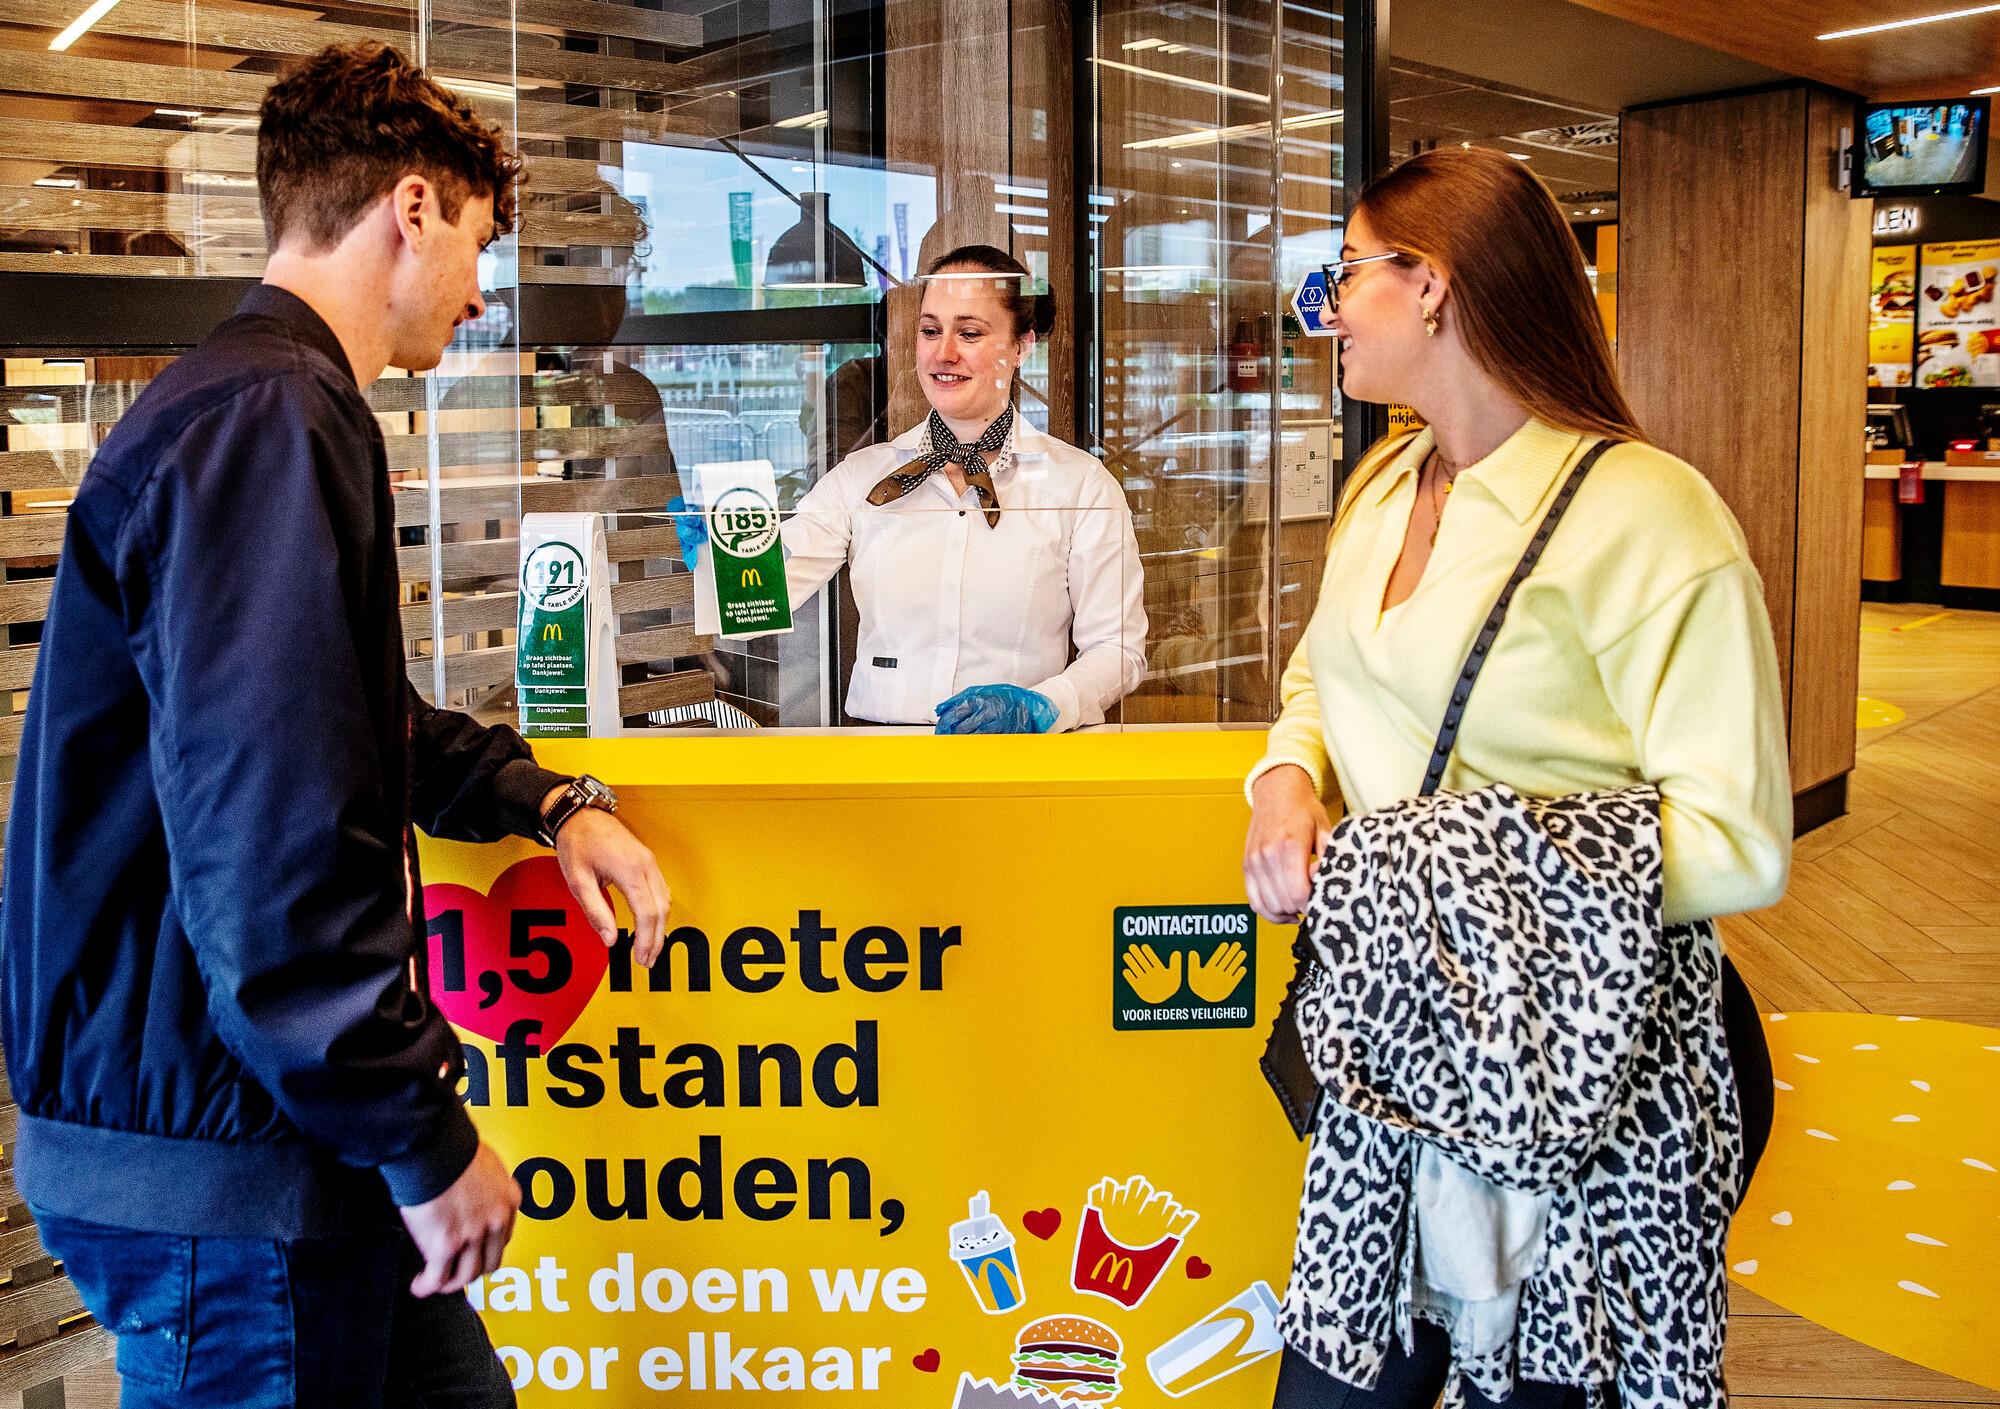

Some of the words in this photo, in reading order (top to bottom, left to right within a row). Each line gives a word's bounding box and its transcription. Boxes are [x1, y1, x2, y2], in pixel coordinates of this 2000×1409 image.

[1872, 208, 1919, 235] LEN
[1301, 303, 1324, 313] record
[1390, 411, 1416, 427] nkje
[721, 506, 767, 531] 185
[741, 545, 761, 554] TABLE
[761, 522, 777, 547] SERVICE
[535, 560, 575, 585] 191
[547, 600, 568, 608] TABLE
[568, 578, 585, 603] SERVICE
[727, 601, 746, 609] Graag
[747, 599, 775, 608] zichtbaar
[725, 610, 734, 618] op
[734, 608, 749, 616] tafel
[750, 606, 779, 615] plaatsen.
[736, 614, 770, 623] Dankjewel.
[532, 669, 565, 677] Dankjewel.
[1122, 913, 1249, 937] CONTACTLOOS
[426, 909, 573, 1010] 1,5
[608, 909, 962, 993] meter
[1122, 1009, 1151, 1021] VOOR
[1153, 1008, 1189, 1021] IEDERS
[1191, 1007, 1248, 1020] VEILIGHEID
[513, 1135, 906, 1238] ouden,
[588, 1252, 789, 1314] doen
[808, 1267, 928, 1313] we
[495, 1345, 619, 1391] oor
[638, 1331, 892, 1392] elkaar
